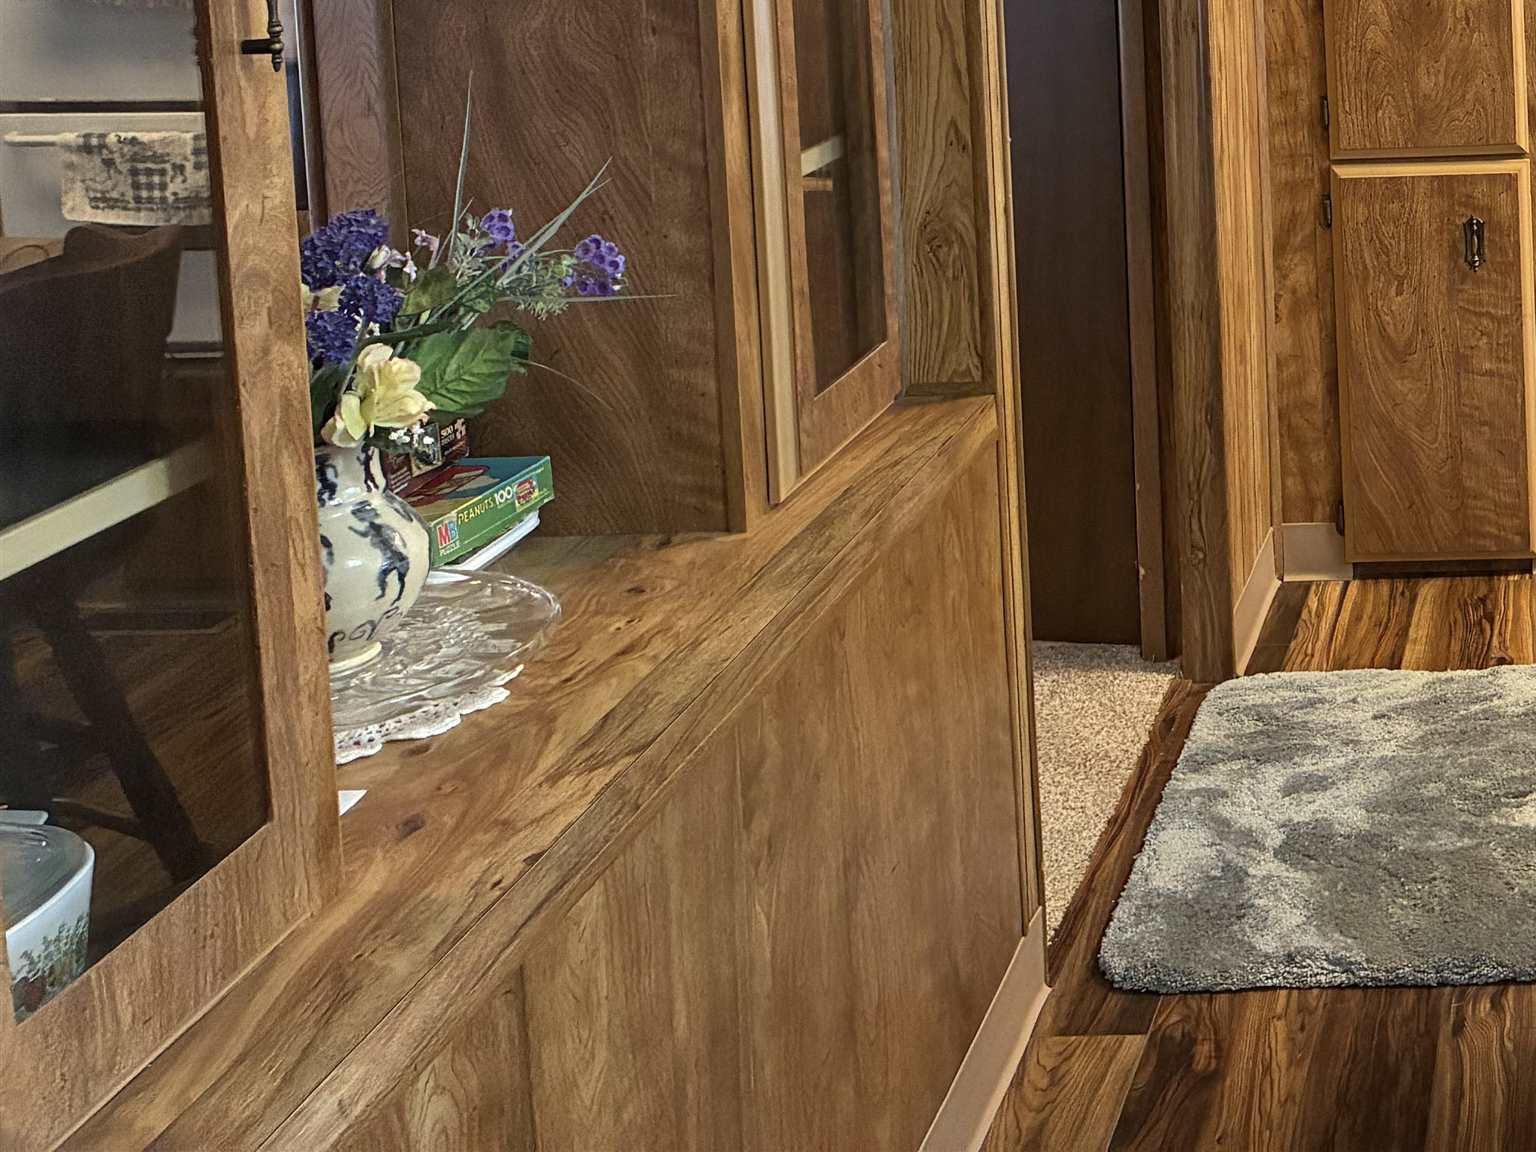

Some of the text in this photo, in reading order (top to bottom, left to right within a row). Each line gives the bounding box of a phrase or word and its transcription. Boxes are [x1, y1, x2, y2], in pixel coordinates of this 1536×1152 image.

[458, 498, 494, 525] PEANUTS
[494, 486, 513, 506] 100
[437, 521, 458, 546] MB
